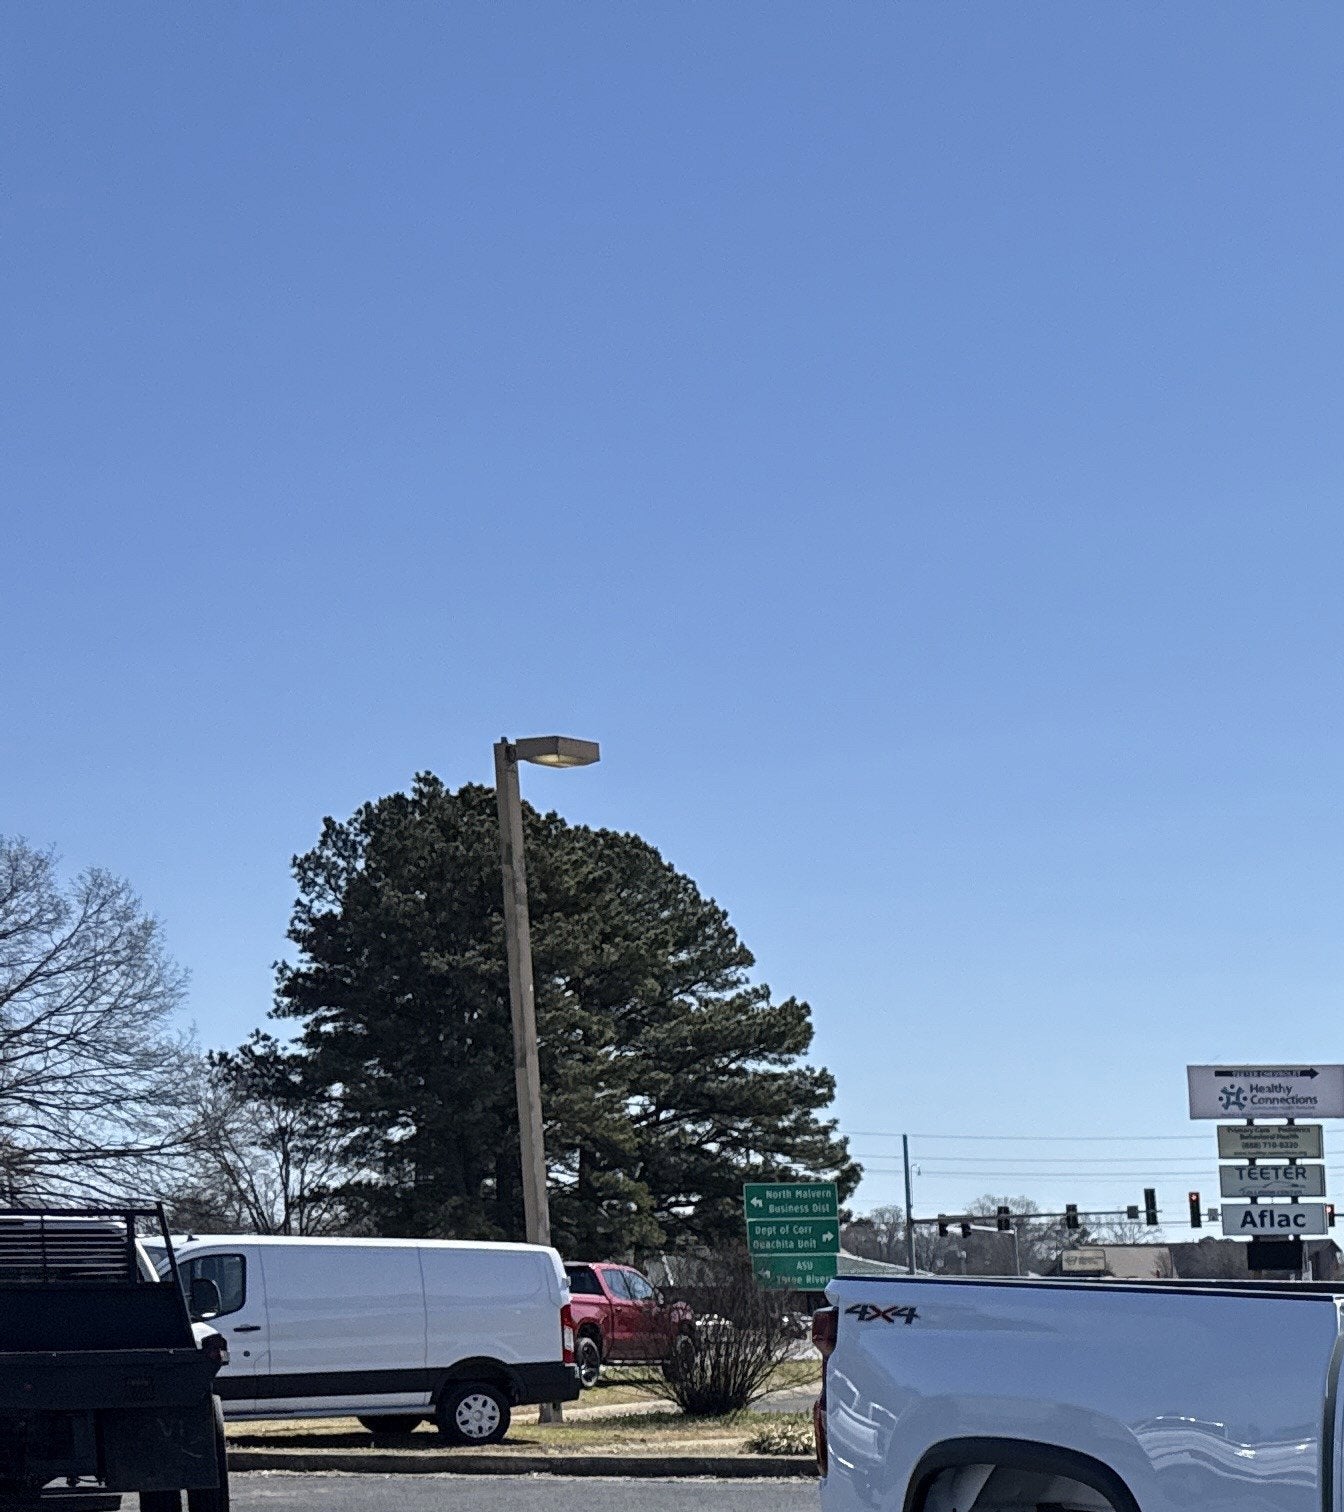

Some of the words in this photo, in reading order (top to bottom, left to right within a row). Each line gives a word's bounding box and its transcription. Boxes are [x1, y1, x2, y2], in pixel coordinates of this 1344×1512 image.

[1250, 1083, 1293, 1096] Healthy
[1250, 1094, 1318, 1105] Connections
[1235, 1166, 1307, 1180] TEETER
[766, 1190, 792, 1199] North
[795, 1189, 832, 1199] Malvern
[768, 1204, 809, 1213] Business
[812, 1203, 830, 1213] Dist
[1240, 1209, 1306, 1228] Aflac
[755, 1225, 777, 1236] Dept
[780, 1224, 789, 1234] of
[793, 1224, 813, 1234] Corr
[753, 1240, 795, 1249] Ouachita
[797, 1239, 817, 1249] Unit
[796, 1261, 813, 1270] ASU
